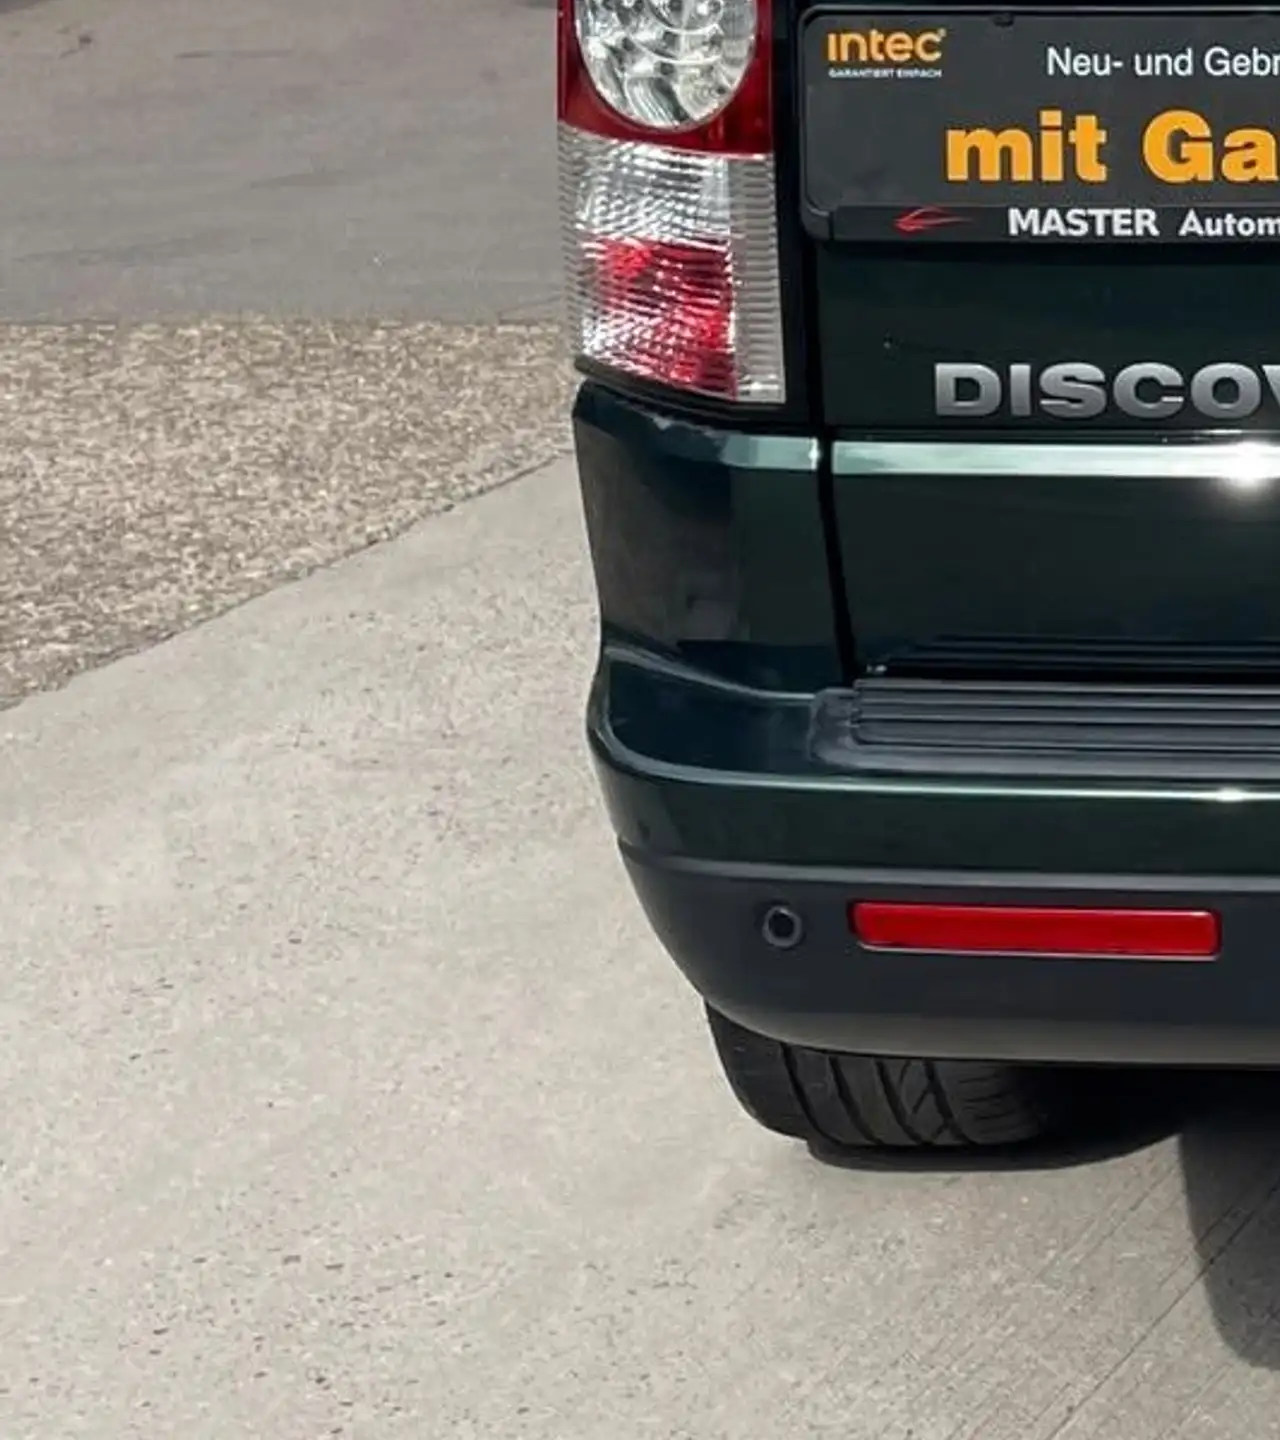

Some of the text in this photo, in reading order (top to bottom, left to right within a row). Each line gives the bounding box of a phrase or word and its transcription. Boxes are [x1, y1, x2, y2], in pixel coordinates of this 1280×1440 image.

[827, 29, 943, 63] intec
[1046, 46, 1124, 77] Neu-
[1133, 46, 1194, 77] und
[945, 110, 1108, 183] mit
[1007, 207, 1160, 238] MASTER
